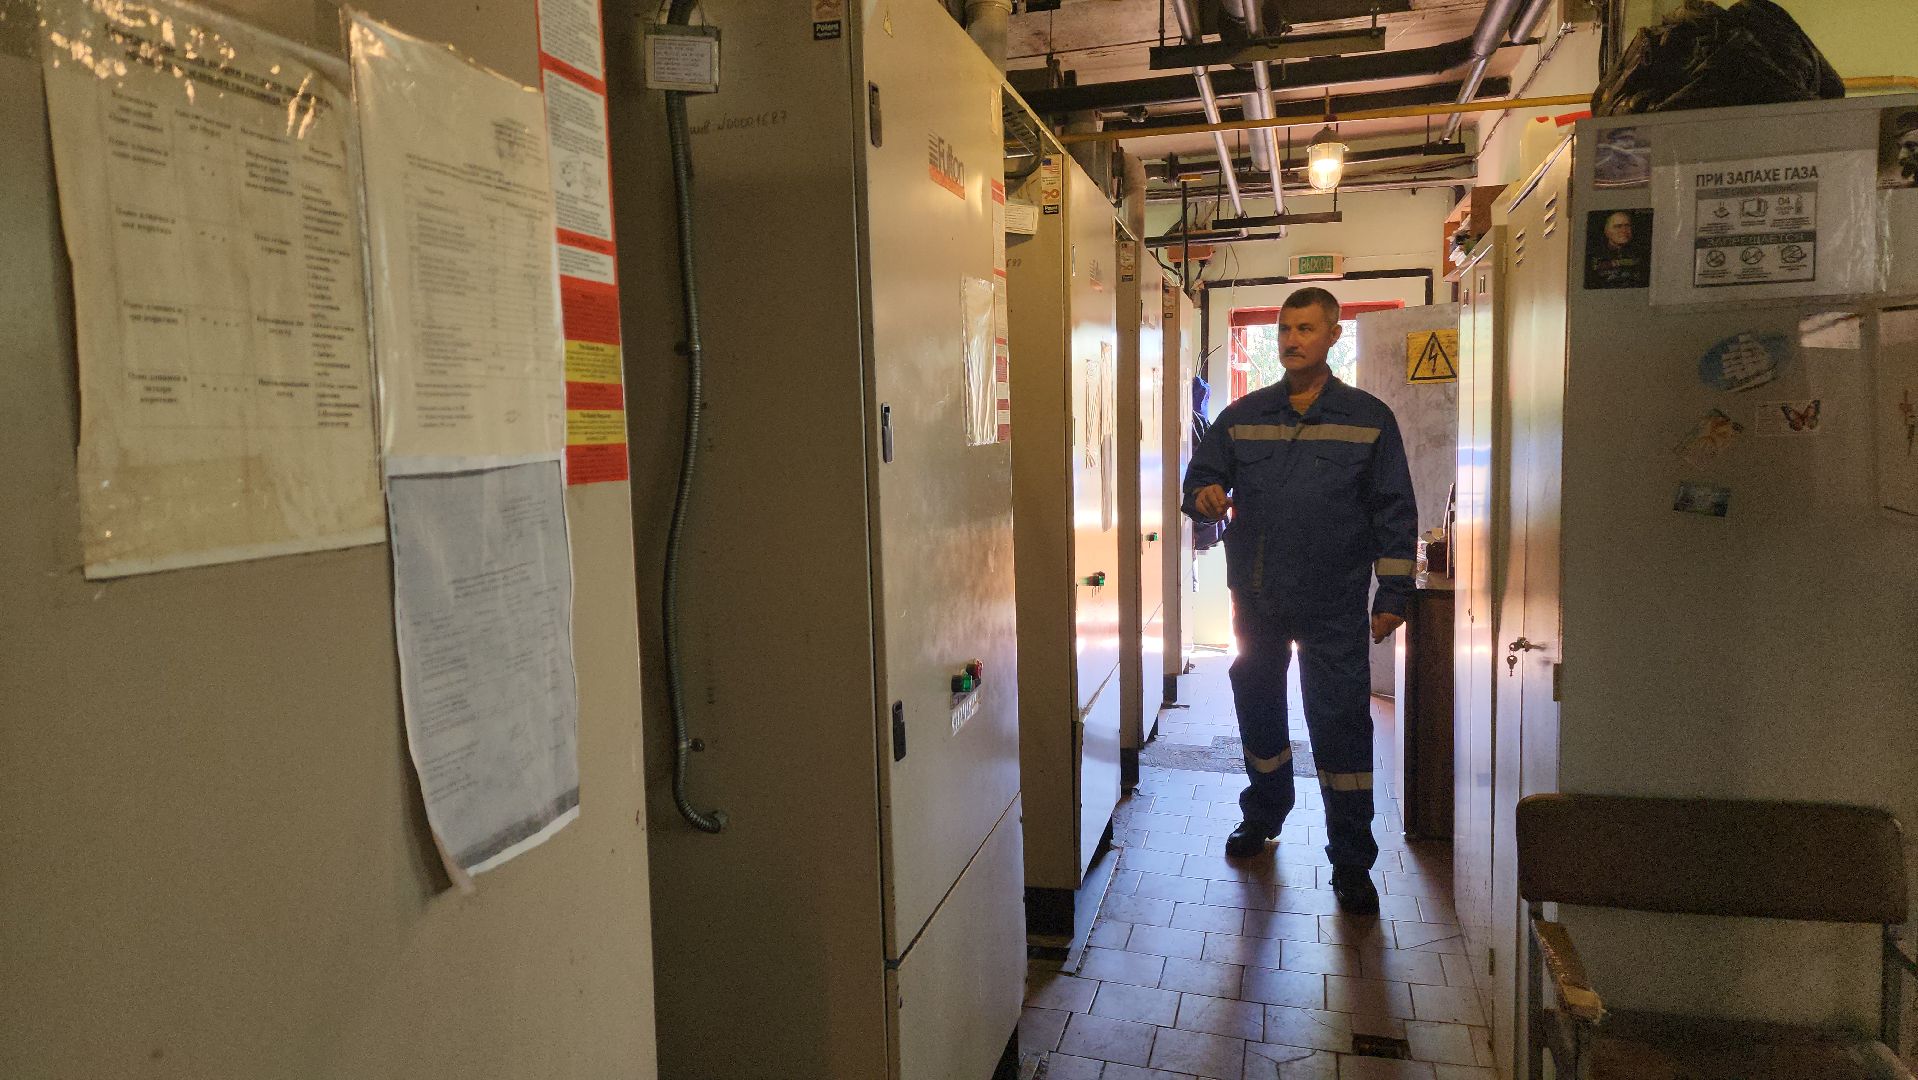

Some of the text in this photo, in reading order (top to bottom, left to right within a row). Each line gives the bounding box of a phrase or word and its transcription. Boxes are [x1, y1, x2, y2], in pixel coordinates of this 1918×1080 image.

[938, 136, 965, 189] Fulton
[1696, 165, 1819, 187] ПРИ ЗАПАХЕ ГАЗА
[1301, 257, 1332, 272] ВЫХОД
